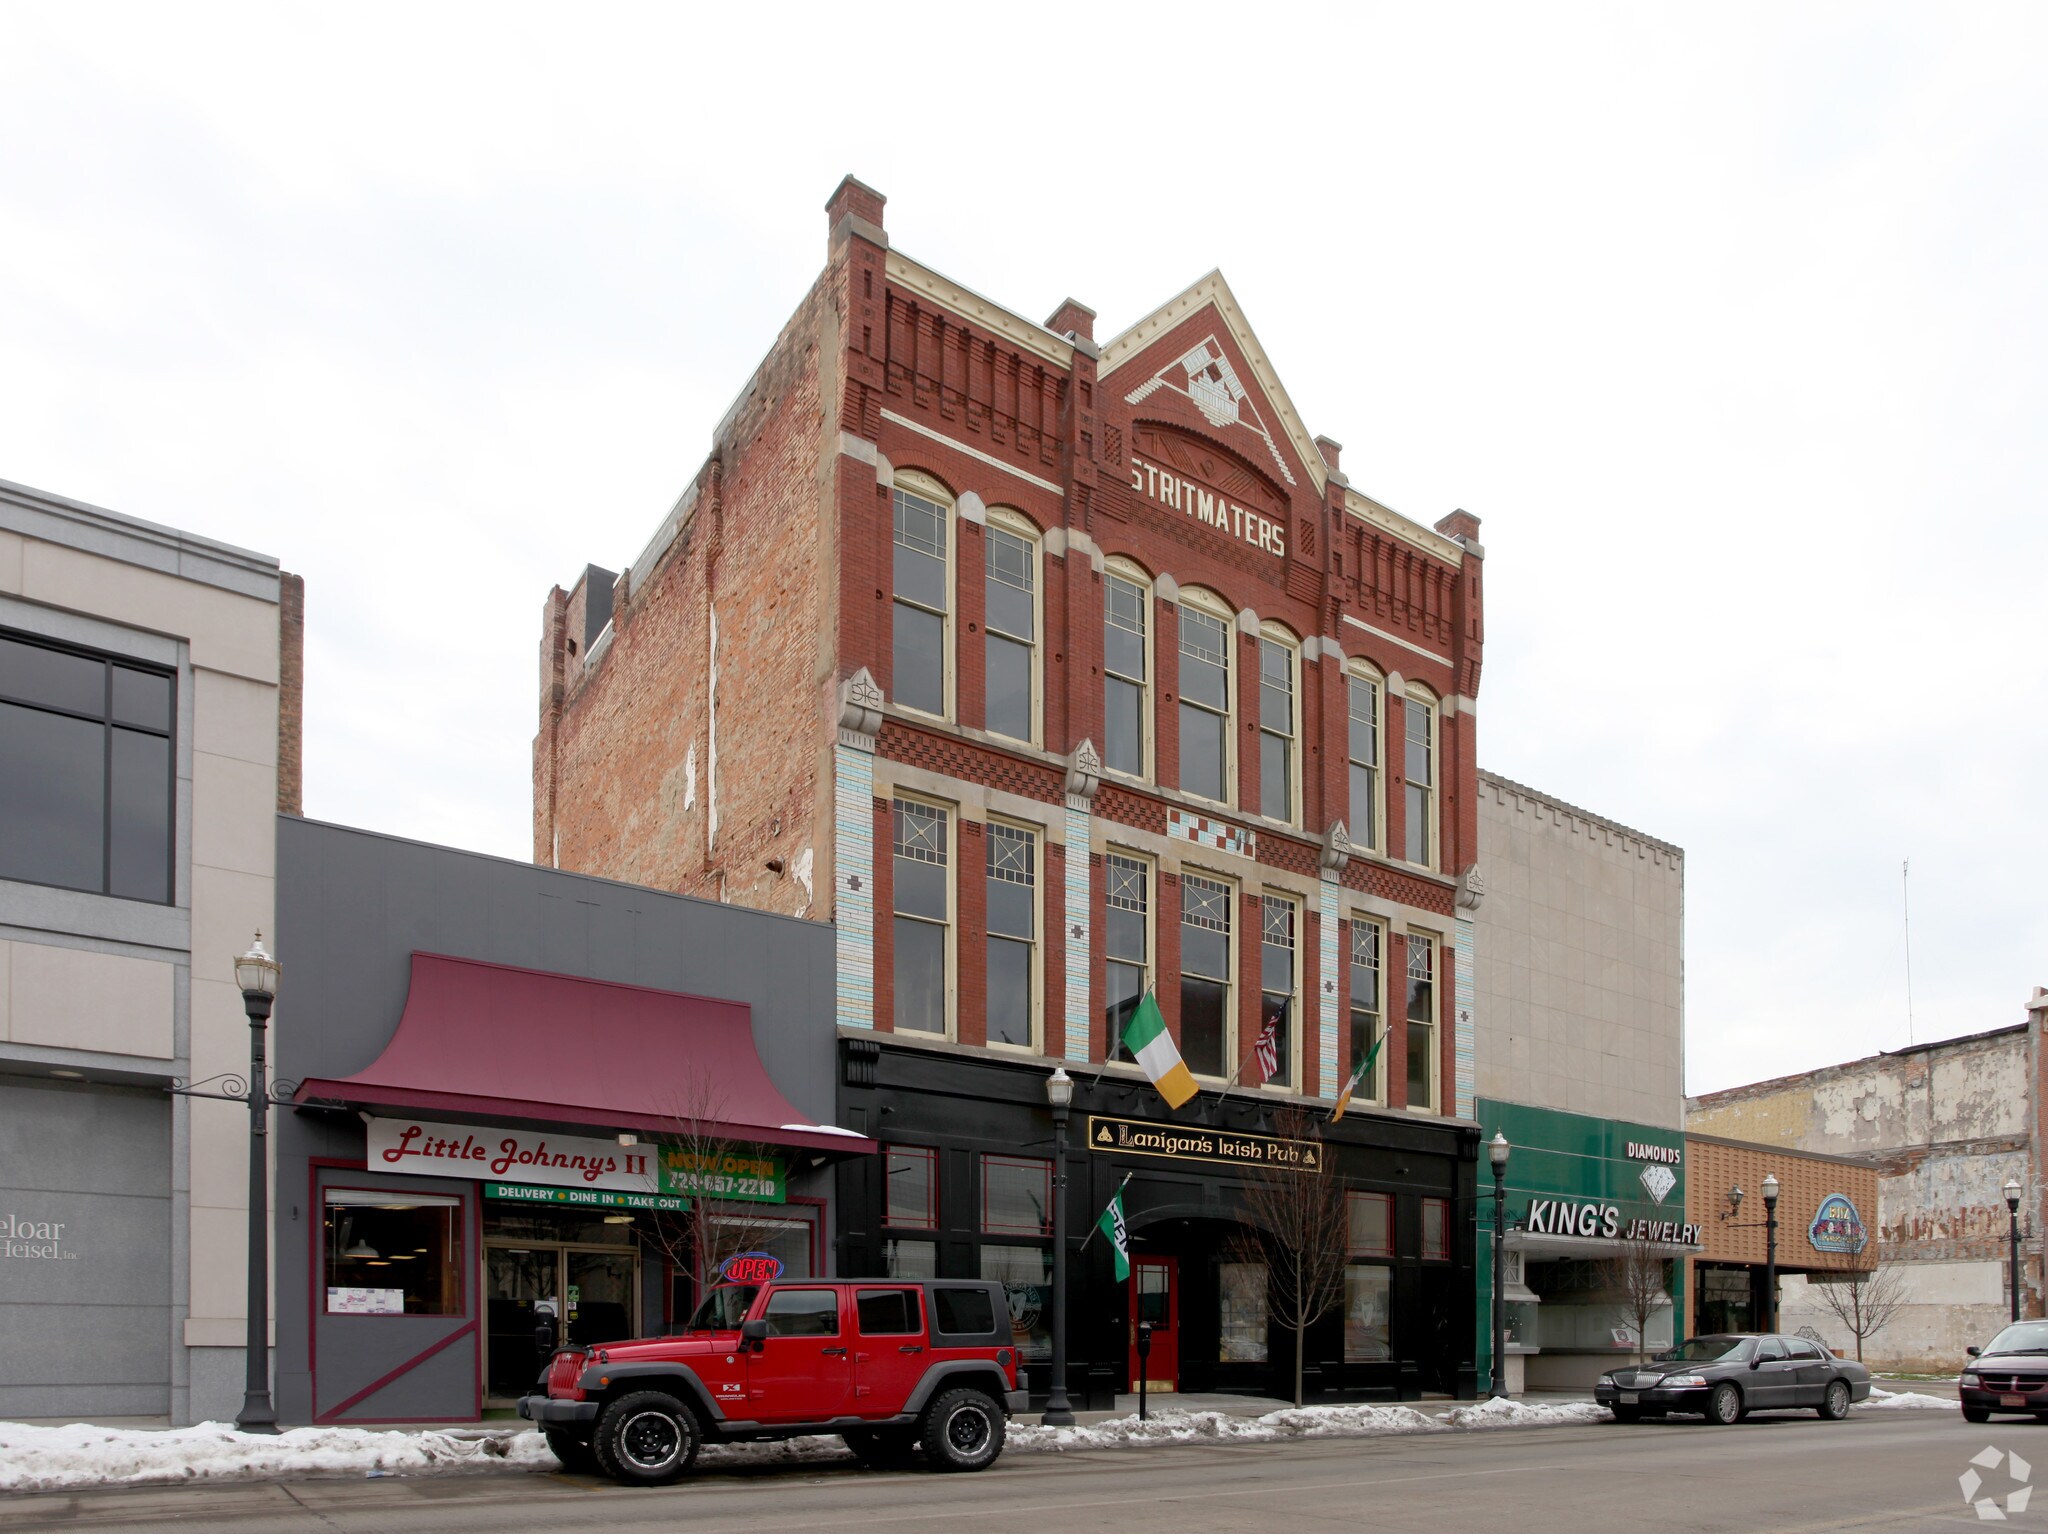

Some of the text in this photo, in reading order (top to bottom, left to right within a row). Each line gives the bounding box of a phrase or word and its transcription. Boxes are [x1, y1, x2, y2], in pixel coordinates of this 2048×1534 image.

[1131, 457, 1285, 558] STRITMATERS
[382, 1125, 648, 1182] Little Johnnys II
[1118, 1124, 1299, 1163] Lanigan's Irish Pub
[1627, 1141, 1681, 1164] DIAMONDS
[668, 1151, 774, 1176] NOW OPEN
[498, 1186, 681, 1209] DELIVERY DINE IN TAKE OUT
[1527, 1199, 1619, 1238] KING'S
[1626, 1218, 1703, 1244] JEWELRY
[727, 1258, 777, 1280] OPEN
